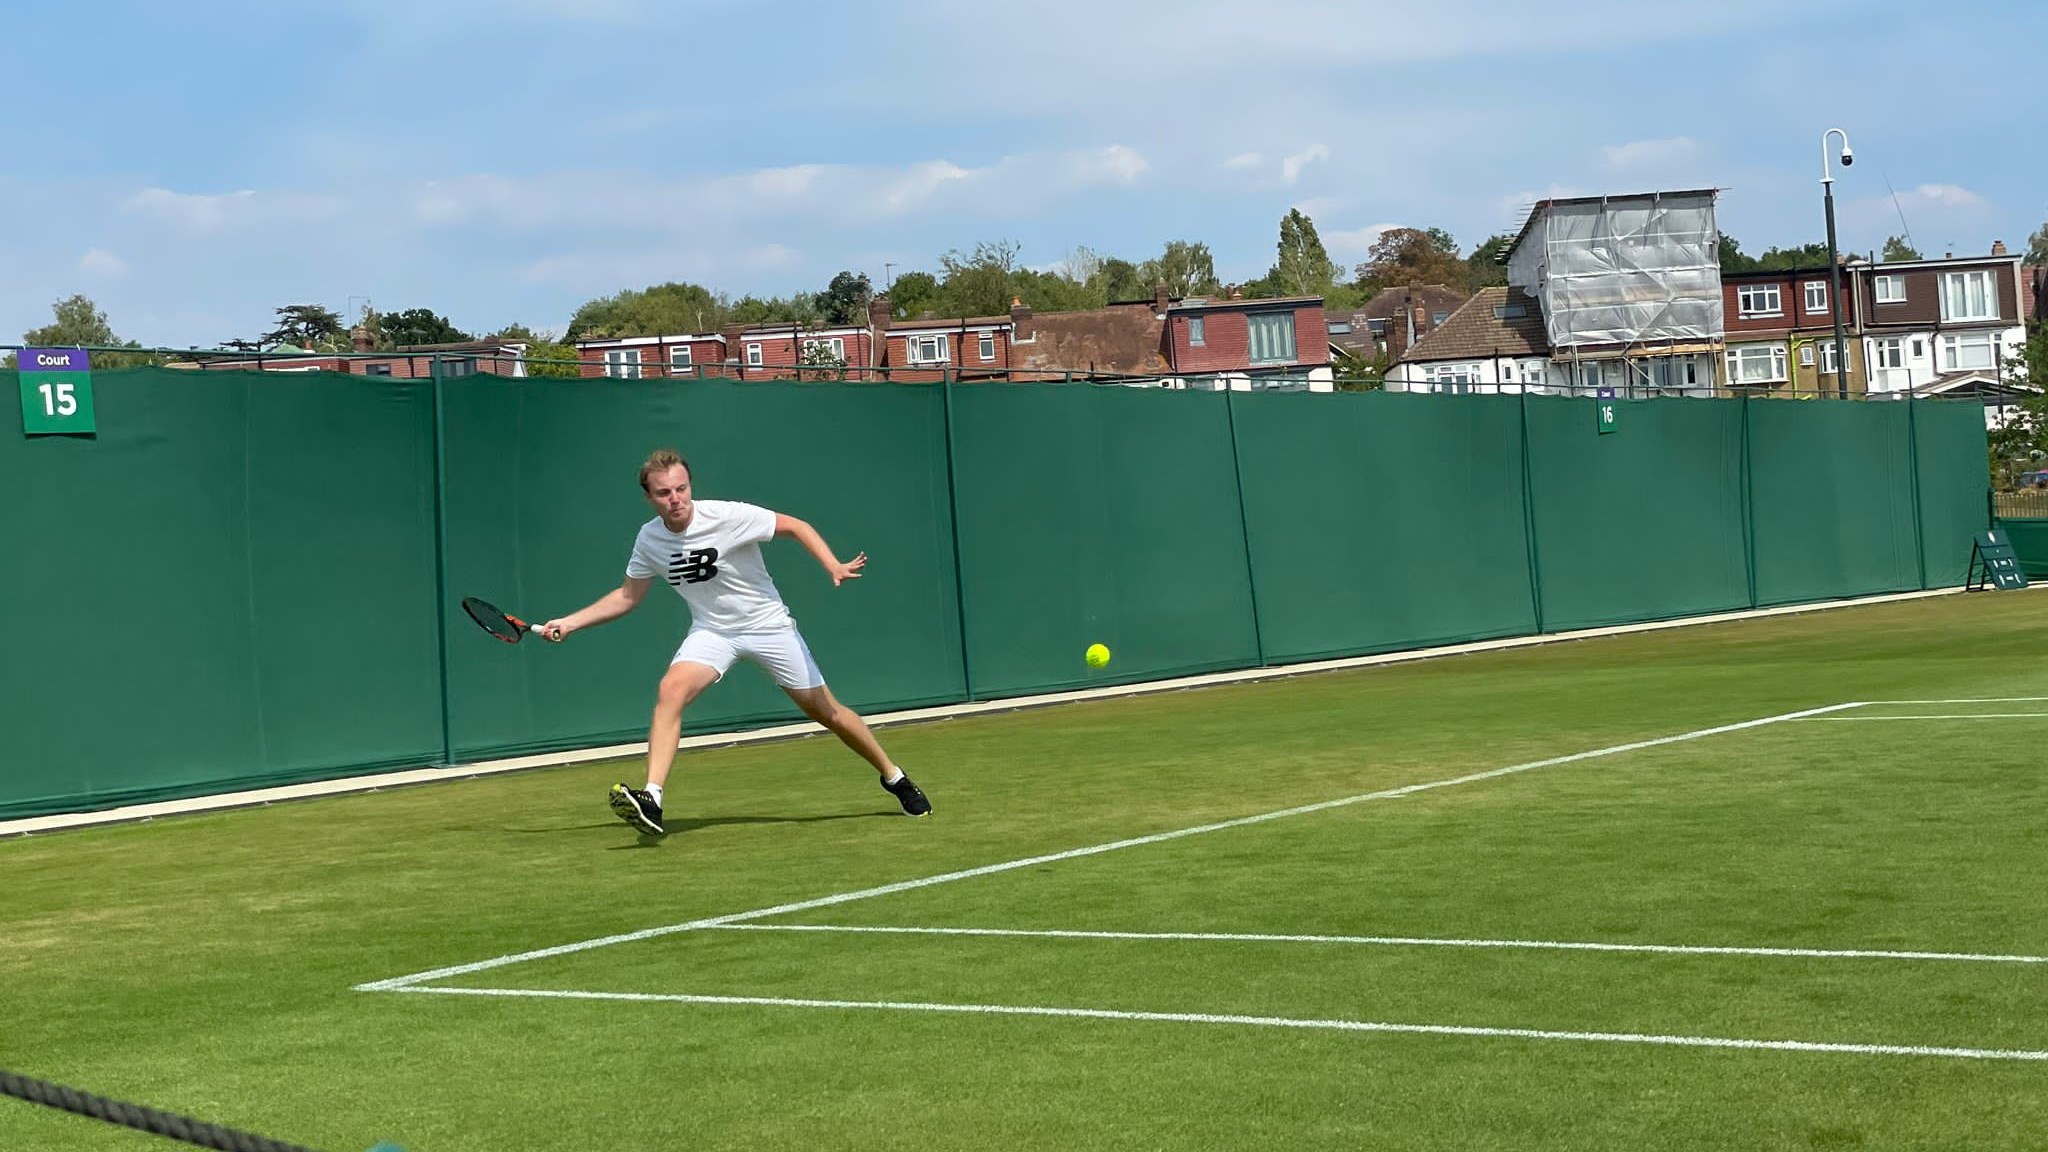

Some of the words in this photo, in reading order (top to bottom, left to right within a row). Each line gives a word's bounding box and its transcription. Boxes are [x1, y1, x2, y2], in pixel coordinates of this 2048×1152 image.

[37, 354, 71, 366] Court
[39, 383, 77, 416] 15
[1602, 406, 1613, 424] 16
